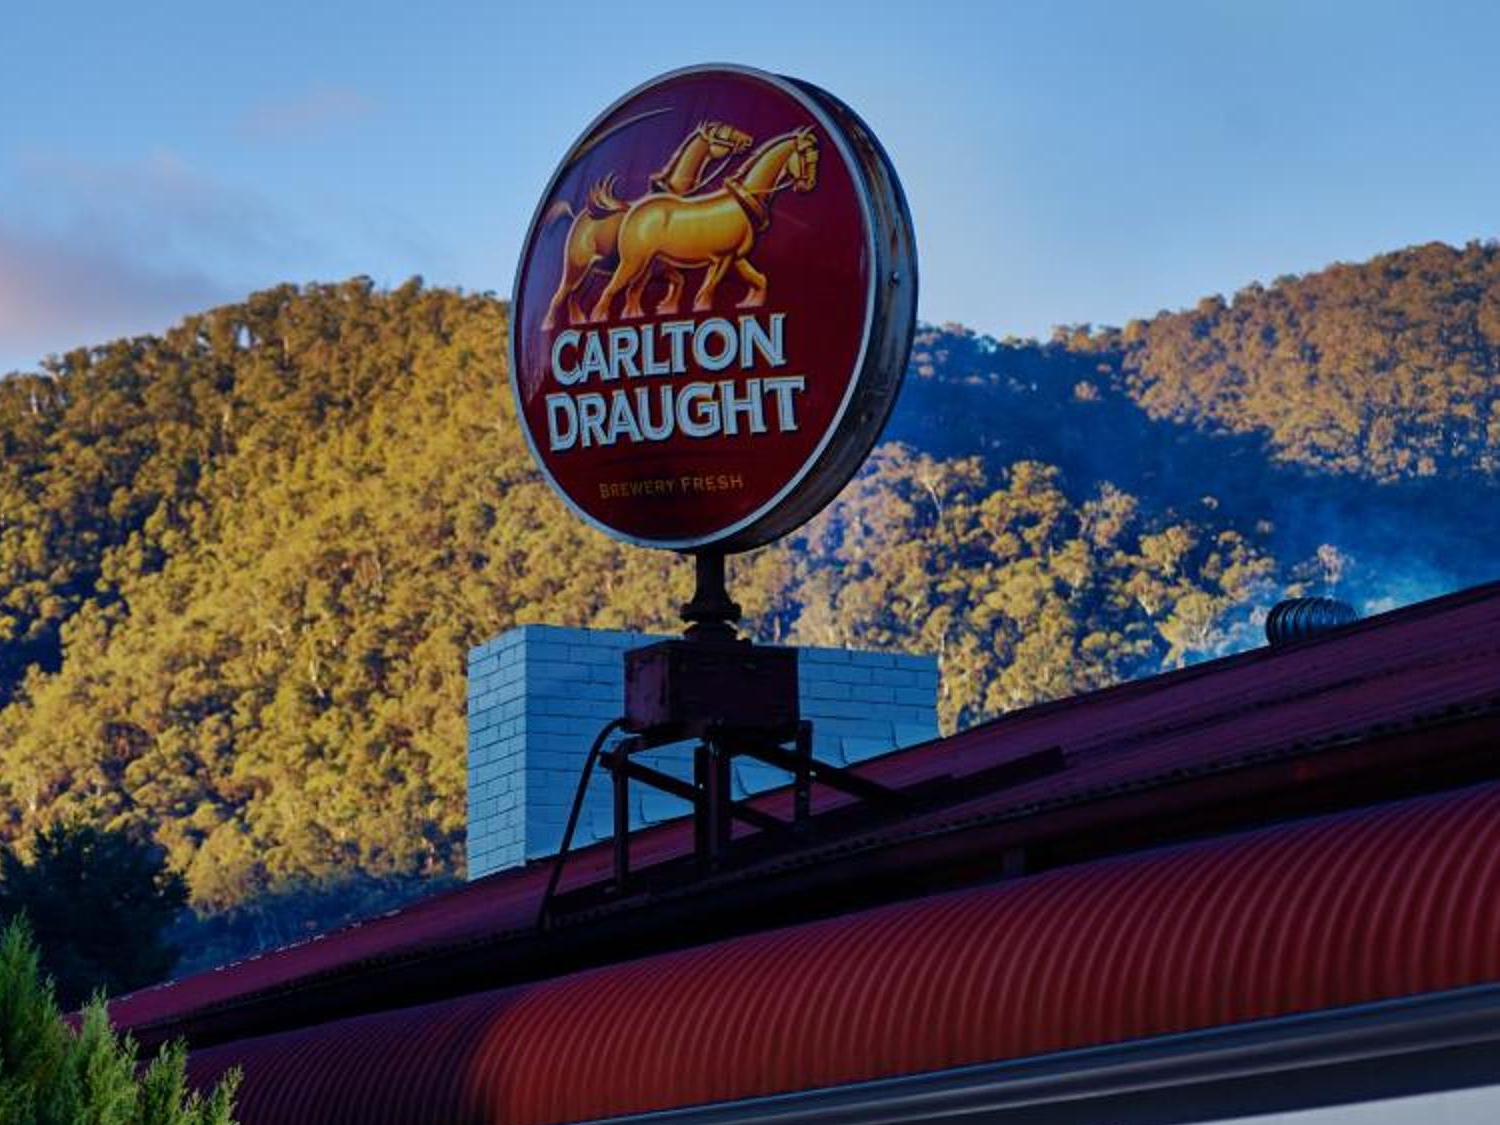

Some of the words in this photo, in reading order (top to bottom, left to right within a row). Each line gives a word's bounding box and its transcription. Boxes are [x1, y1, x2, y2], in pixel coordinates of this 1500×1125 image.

[551, 312, 787, 385] CARLTON
[545, 376, 805, 451] DRAUGHT
[599, 480, 676, 499] BREWERY
[680, 474, 744, 494] FRESH
